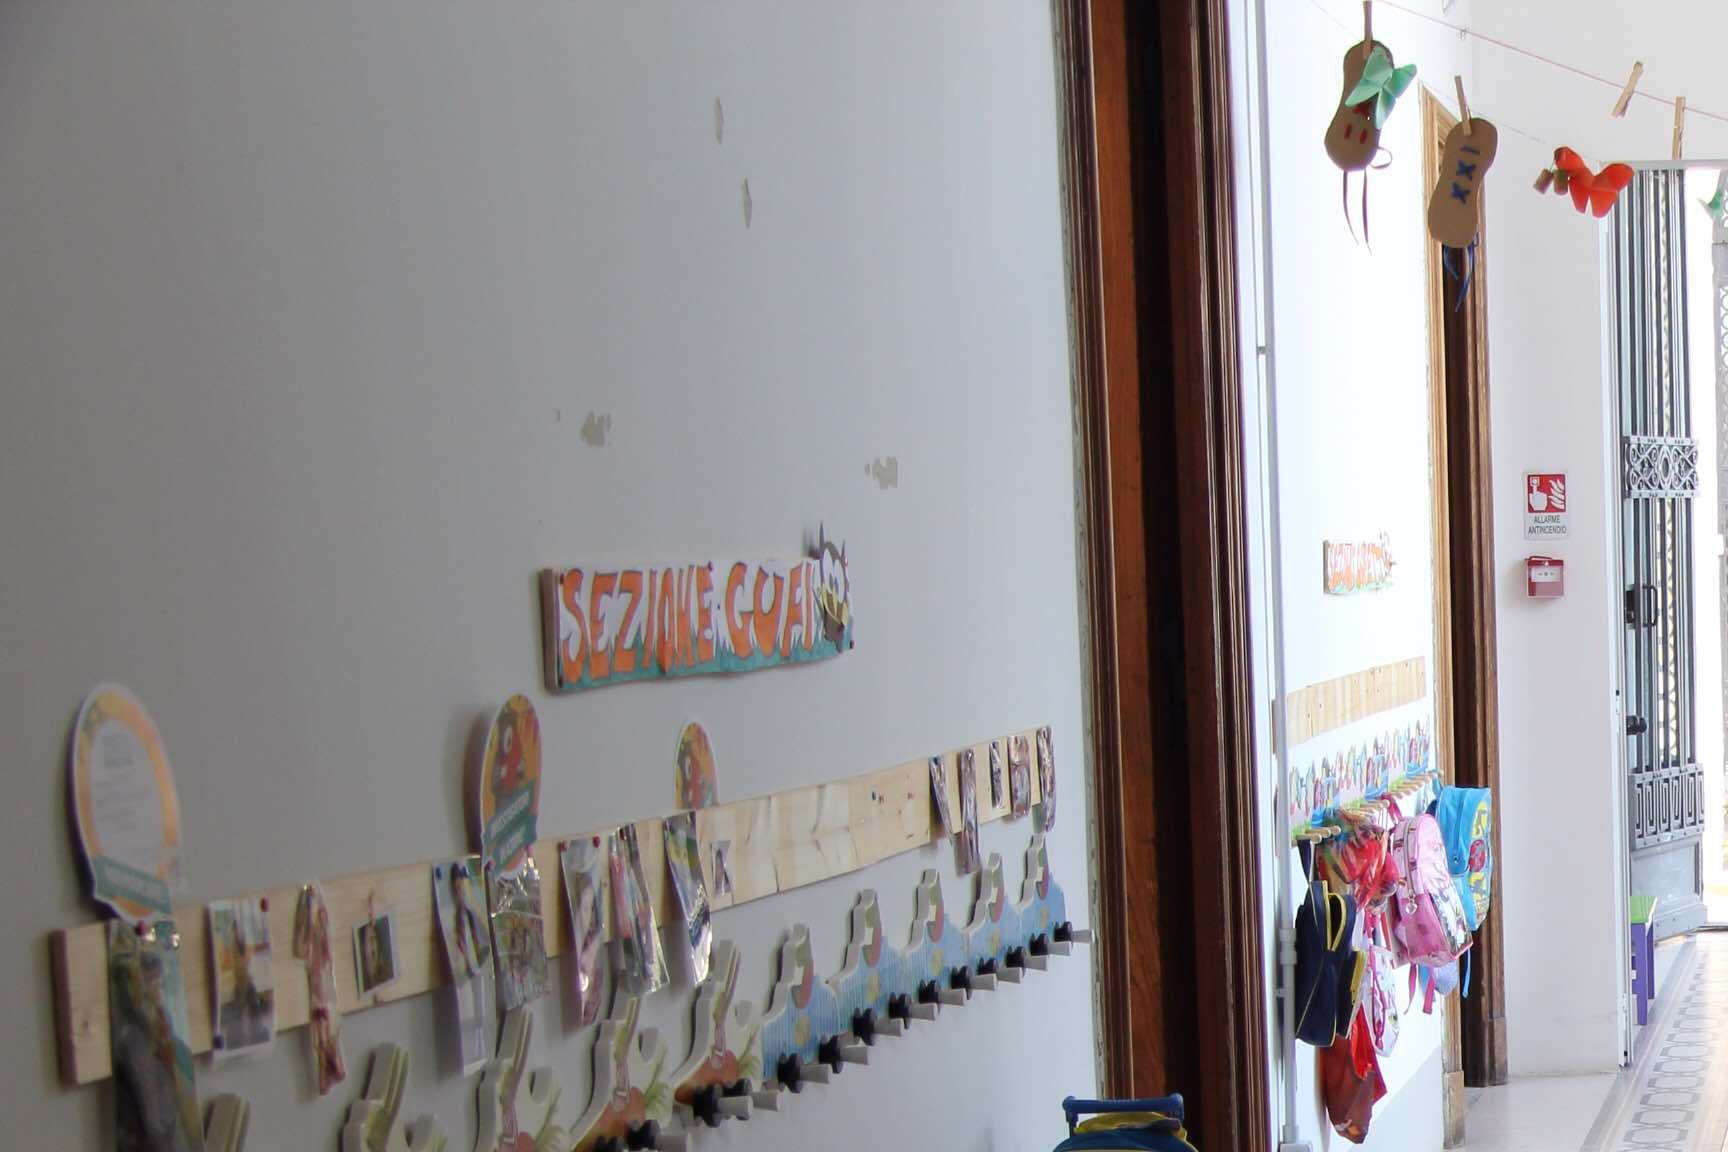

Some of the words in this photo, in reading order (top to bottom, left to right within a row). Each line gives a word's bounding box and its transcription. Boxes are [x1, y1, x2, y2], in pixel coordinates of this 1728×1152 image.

[1534, 515, 1561, 524] ALLARME
[1528, 525, 1566, 534] ANTINCENDIO
[561, 562, 715, 684] SEZIONE
